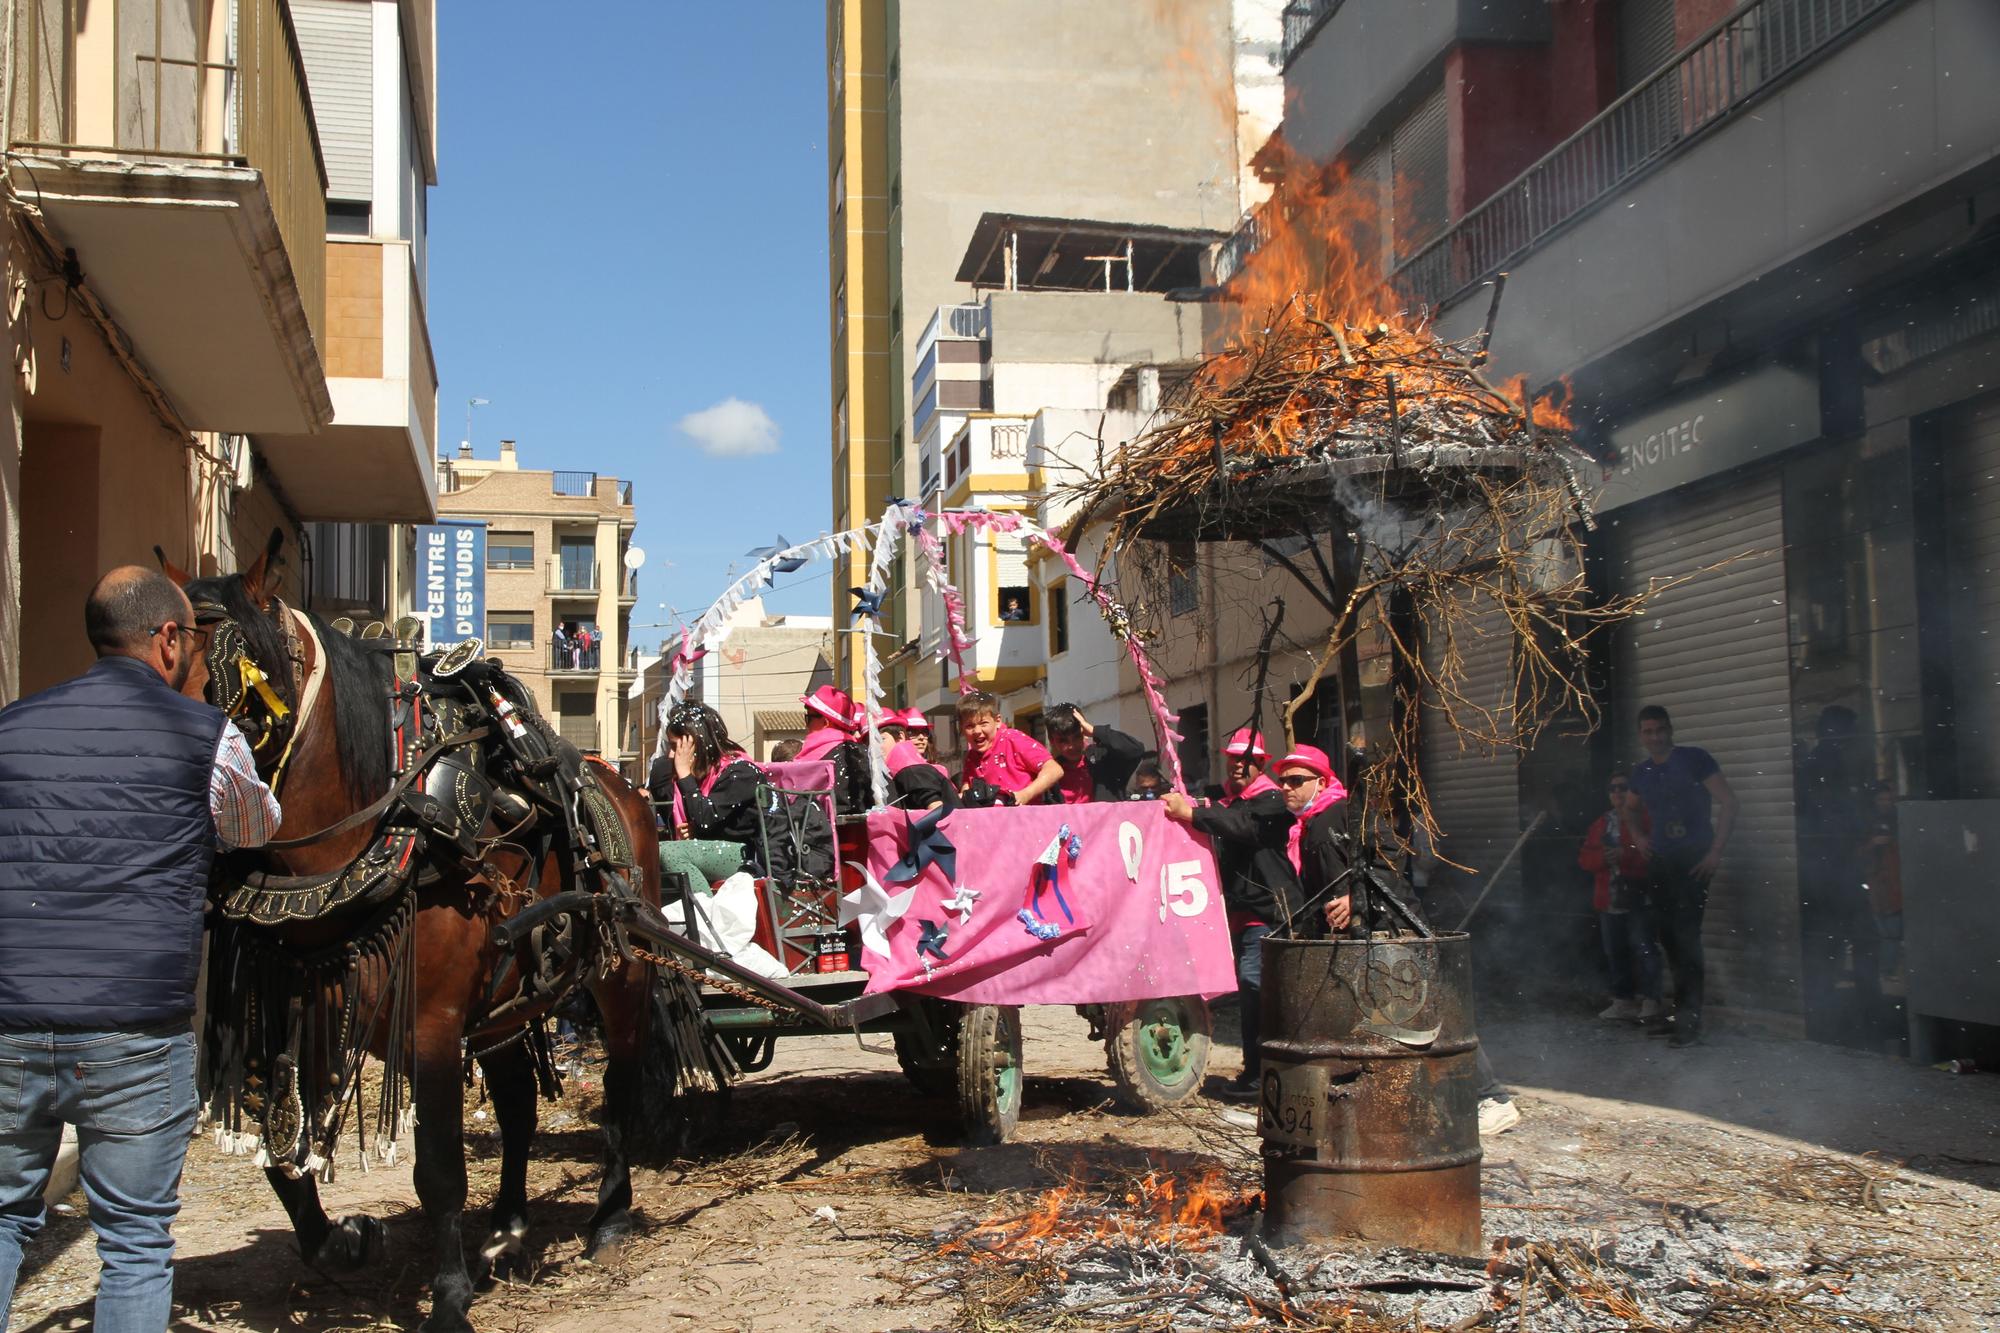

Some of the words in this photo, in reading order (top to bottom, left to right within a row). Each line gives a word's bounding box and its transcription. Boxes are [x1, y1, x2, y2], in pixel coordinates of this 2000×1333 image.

[427, 532, 446, 619] CENTRE
[455, 529, 474, 635] D'ESTUDIS
[1285, 1106, 1314, 1137] 94
